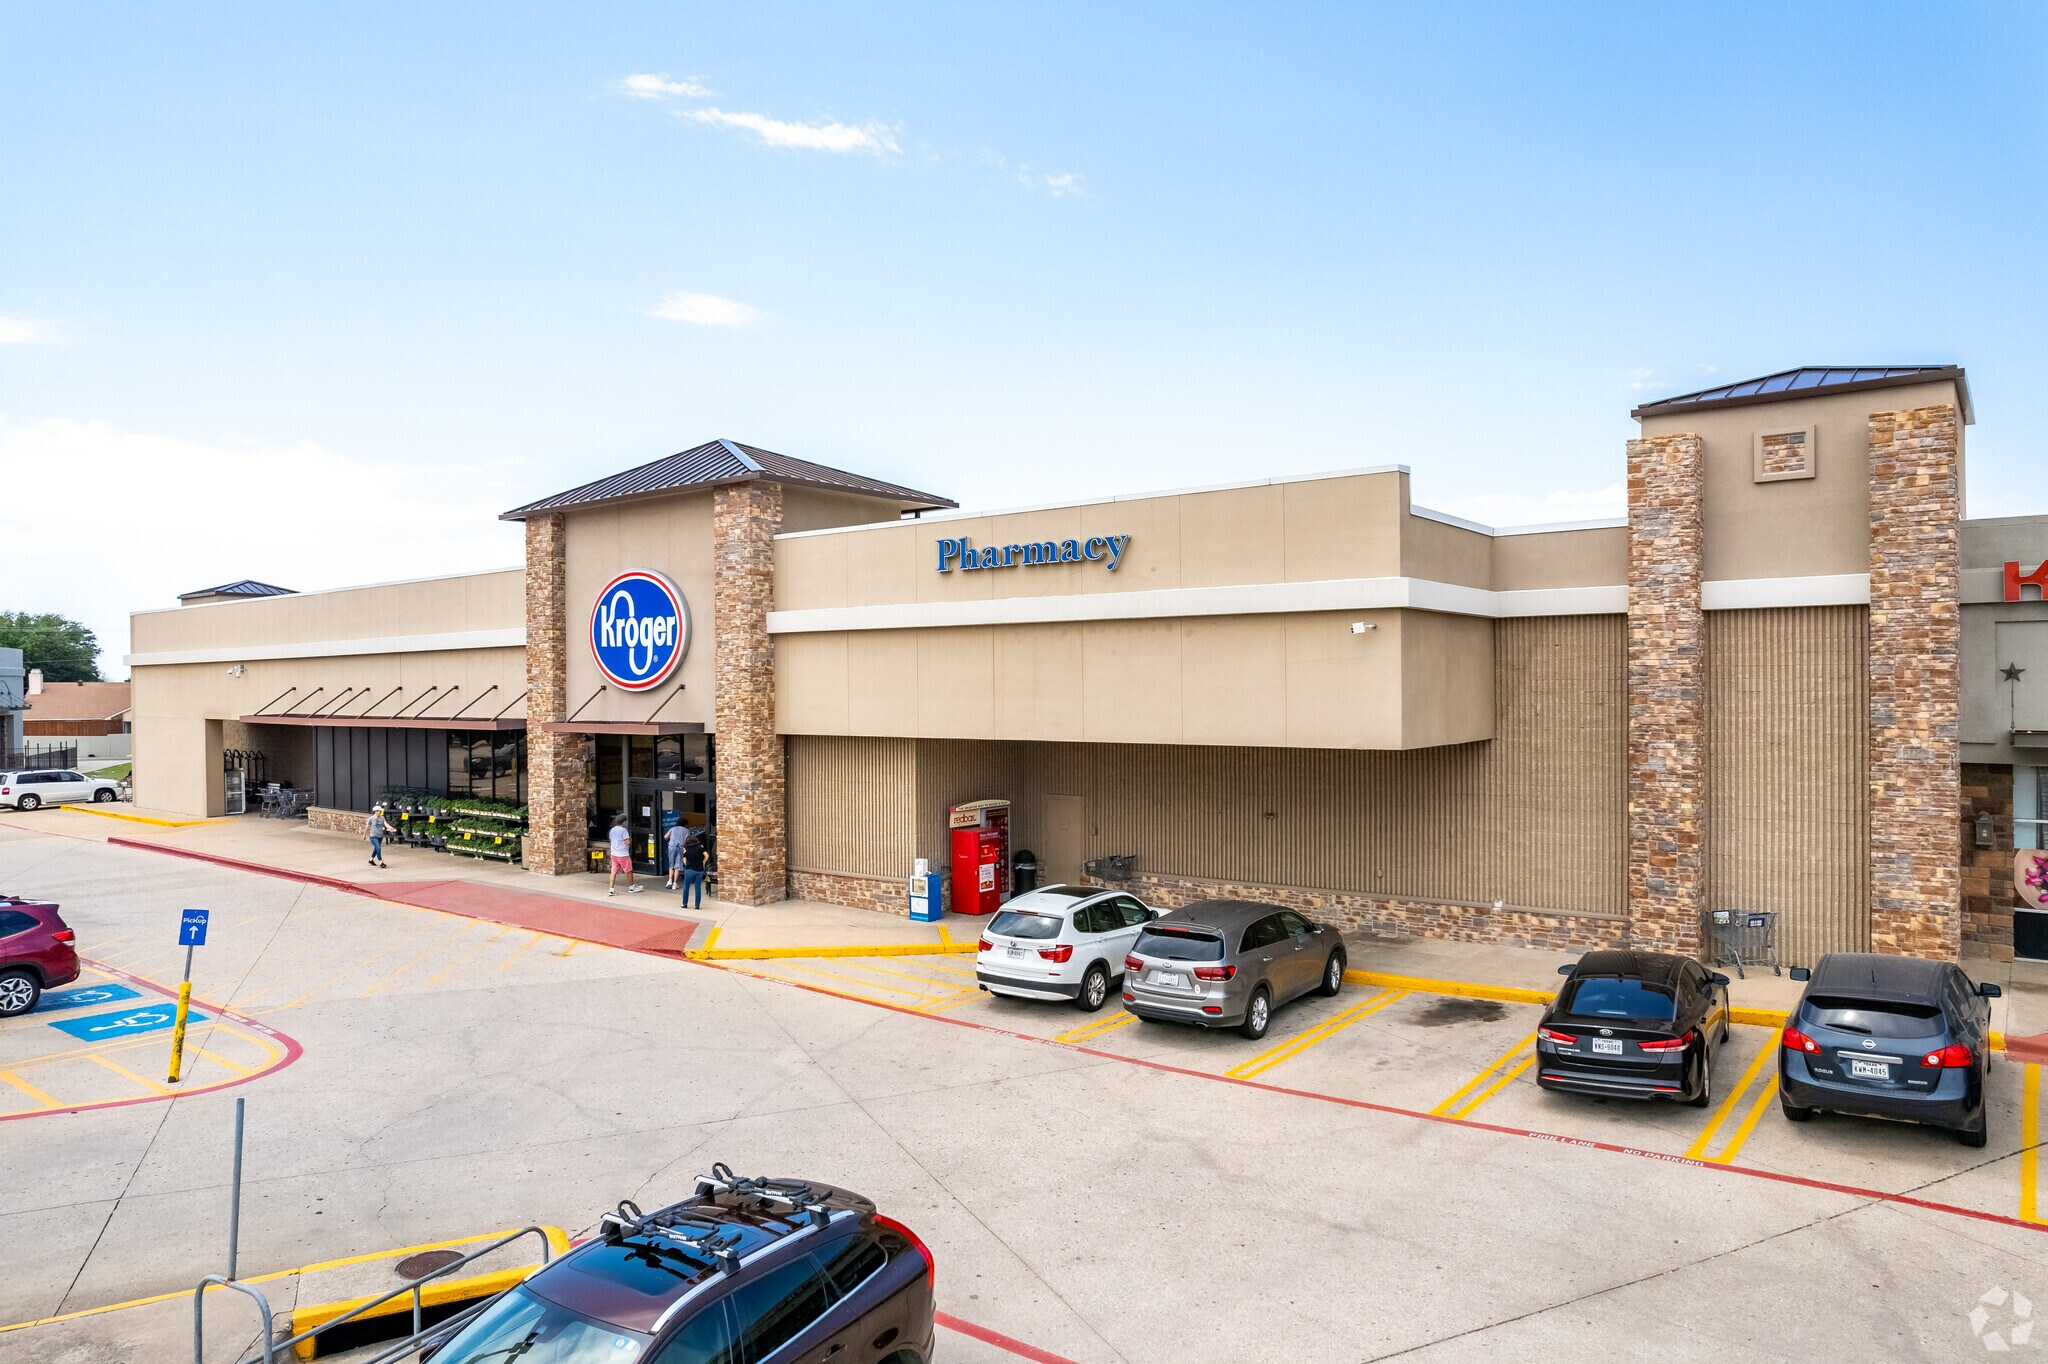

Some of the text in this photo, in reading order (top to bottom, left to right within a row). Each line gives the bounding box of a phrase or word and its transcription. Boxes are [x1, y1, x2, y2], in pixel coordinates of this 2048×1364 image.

[936, 535, 1130, 572] Pharmacy
[600, 590, 676, 676] Kroger
[953, 813, 977, 825] redbox
[1528, 1132, 1596, 1148] FIRE LANE
[1623, 1148, 1705, 1167] NO PARKING
